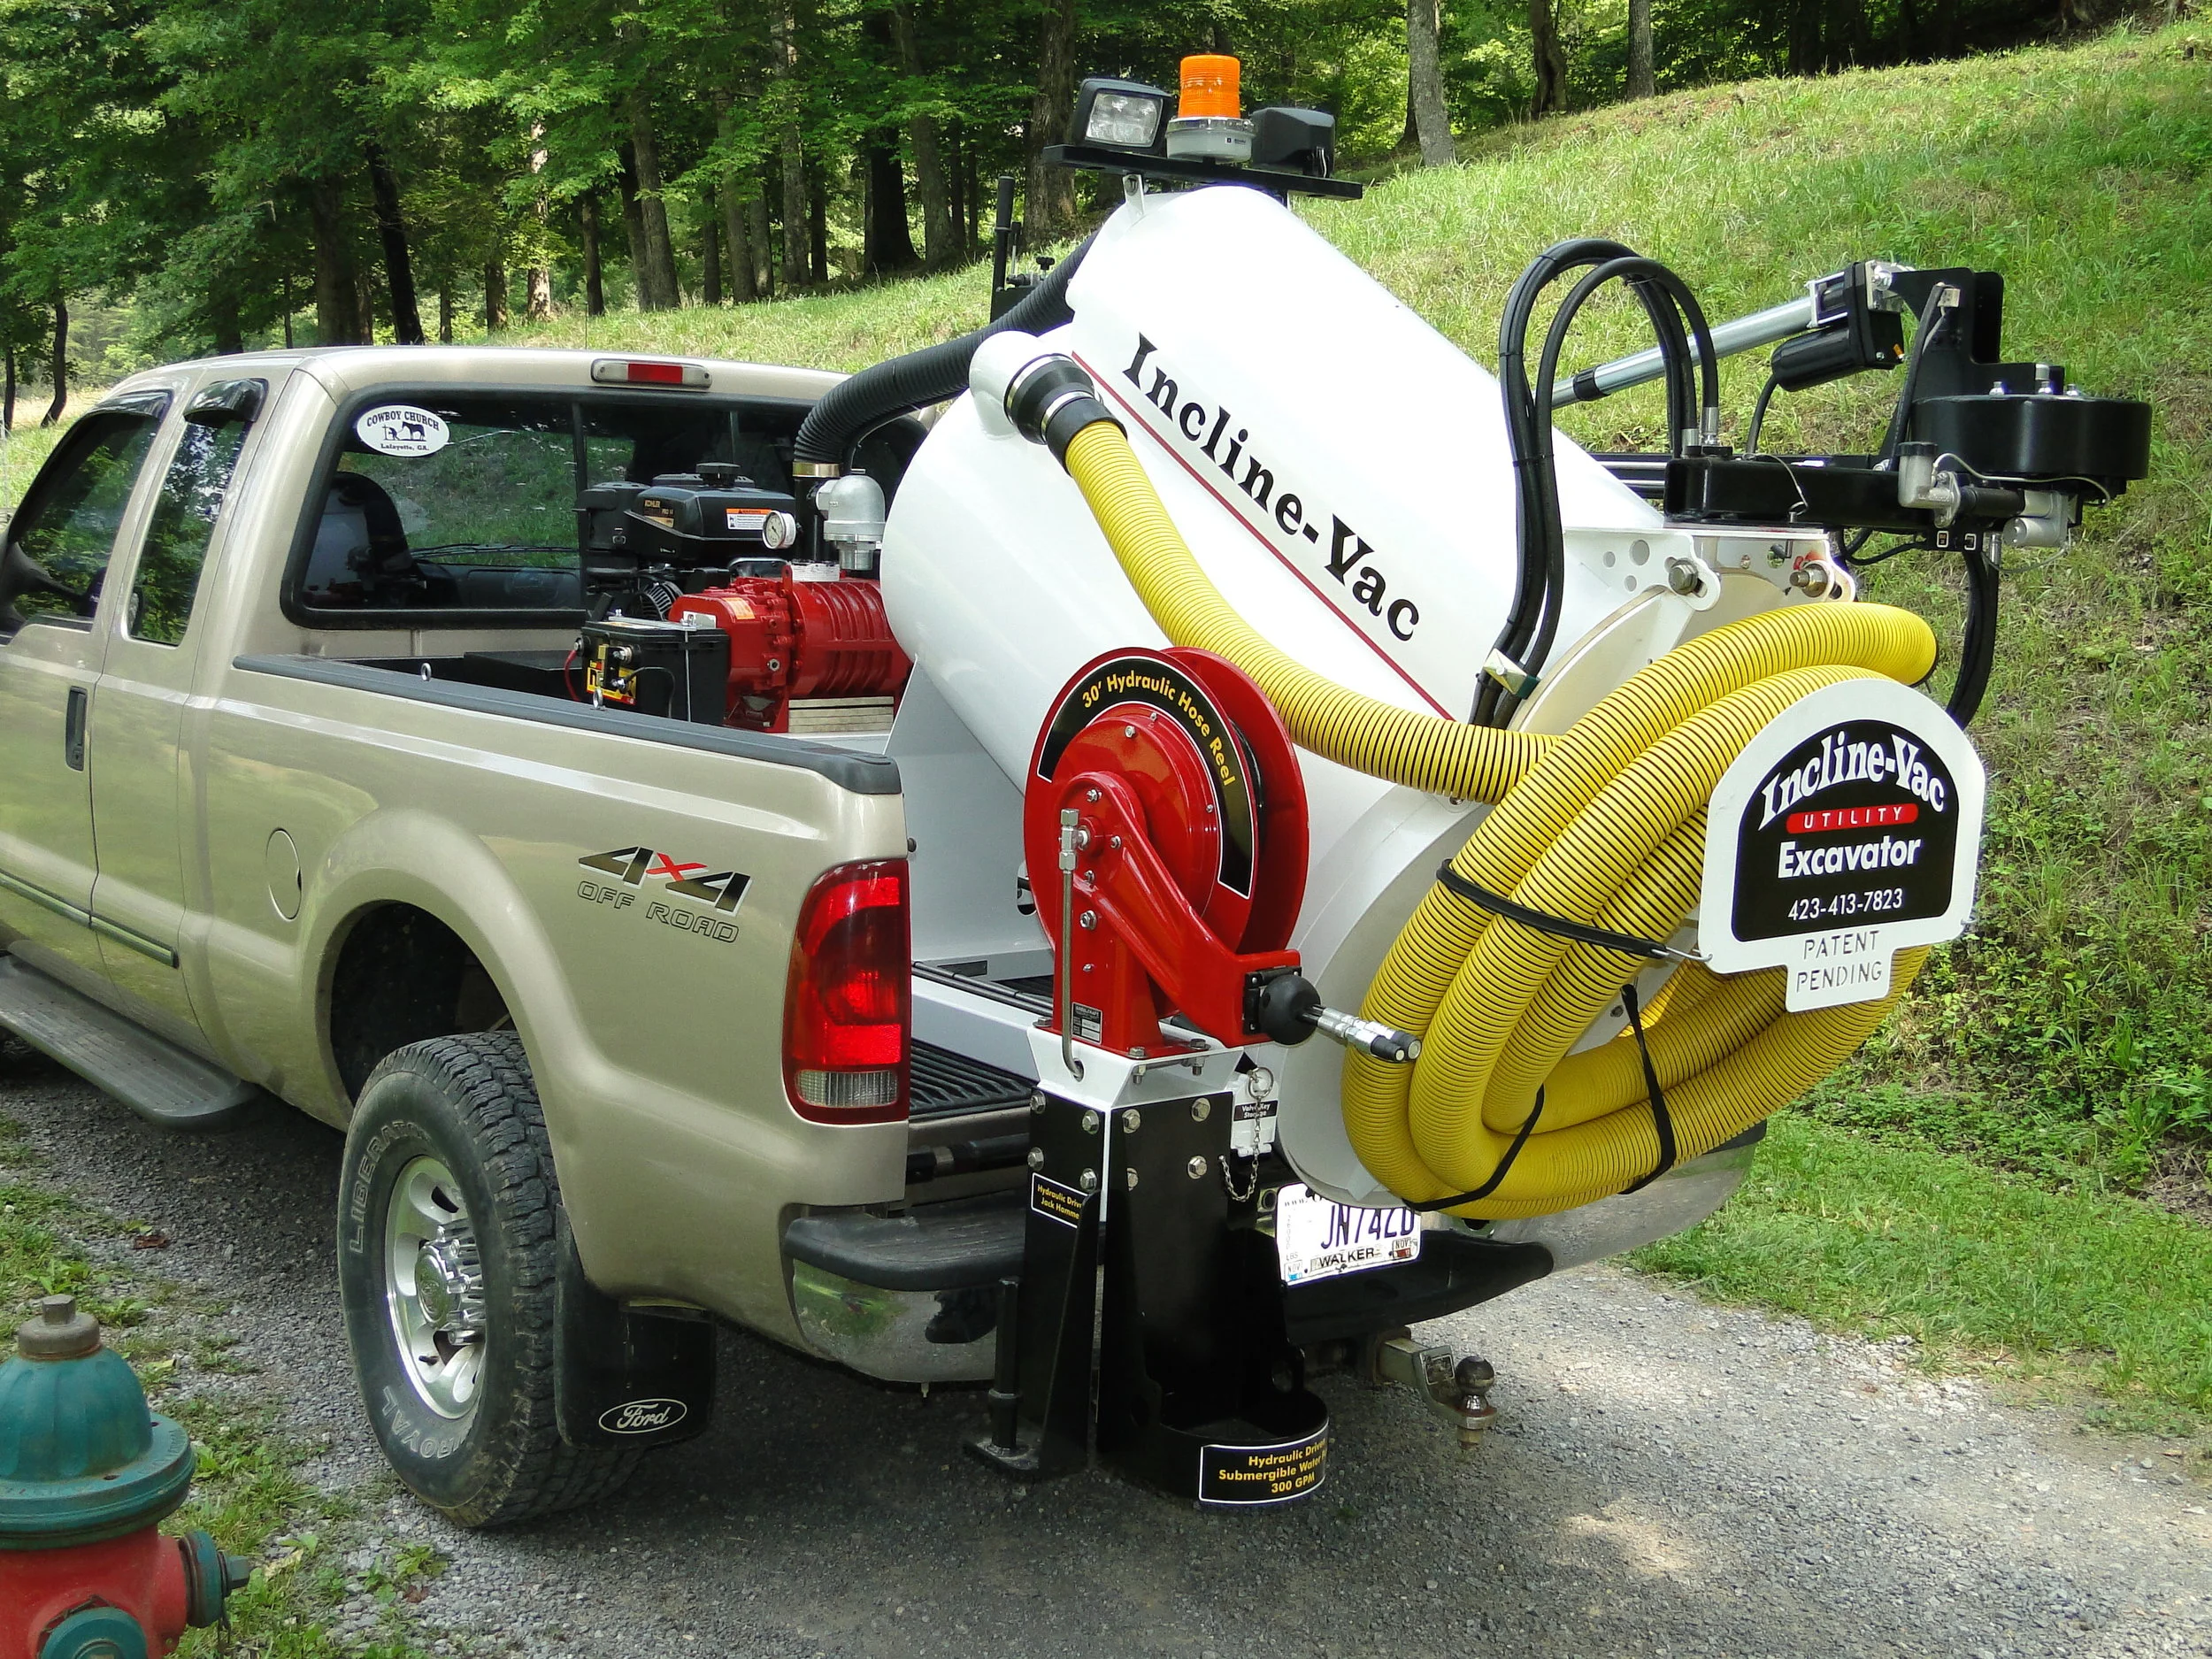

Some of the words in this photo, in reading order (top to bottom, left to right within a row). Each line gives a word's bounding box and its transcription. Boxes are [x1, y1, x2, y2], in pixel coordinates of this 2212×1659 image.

[367, 411, 402, 426] COWBOY
[404, 411, 440, 431] CHURCH
[1122, 332, 1419, 641] Incline-Vac
[1082, 680, 1102, 709] 30'
[1106, 670, 1176, 701] Hydraulic
[1178, 691, 1211, 737] Hose
[1209, 736, 1236, 787] Reel
[1757, 731, 1945, 832] Incline-Vac
[1803, 807, 1905, 830] UTILITY
[1778, 834, 1923, 879] Excavator
[577, 880, 636, 910] OFF
[645, 901, 740, 944] ROAD
[1787, 887, 1903, 921] 423-413-7823
[1803, 929, 1880, 961] PATENT
[1795, 961, 1883, 993] PENDING
[1037, 1183, 1066, 1203] Hydraulic
[1041, 1196, 1055, 1210] Jack
[1056, 1203, 1080, 1219] Hamme
[1319, 1247, 1375, 1268] WALKER
[617, 1402, 672, 1429] Ford
[1218, 1465, 1296, 1482] Submergible
[1299, 1457, 1321, 1473] Water
[1248, 1449, 1303, 1469] Hydraulic
[1271, 1479, 1292, 1494] 300
[1294, 1471, 1315, 1488] GPM
